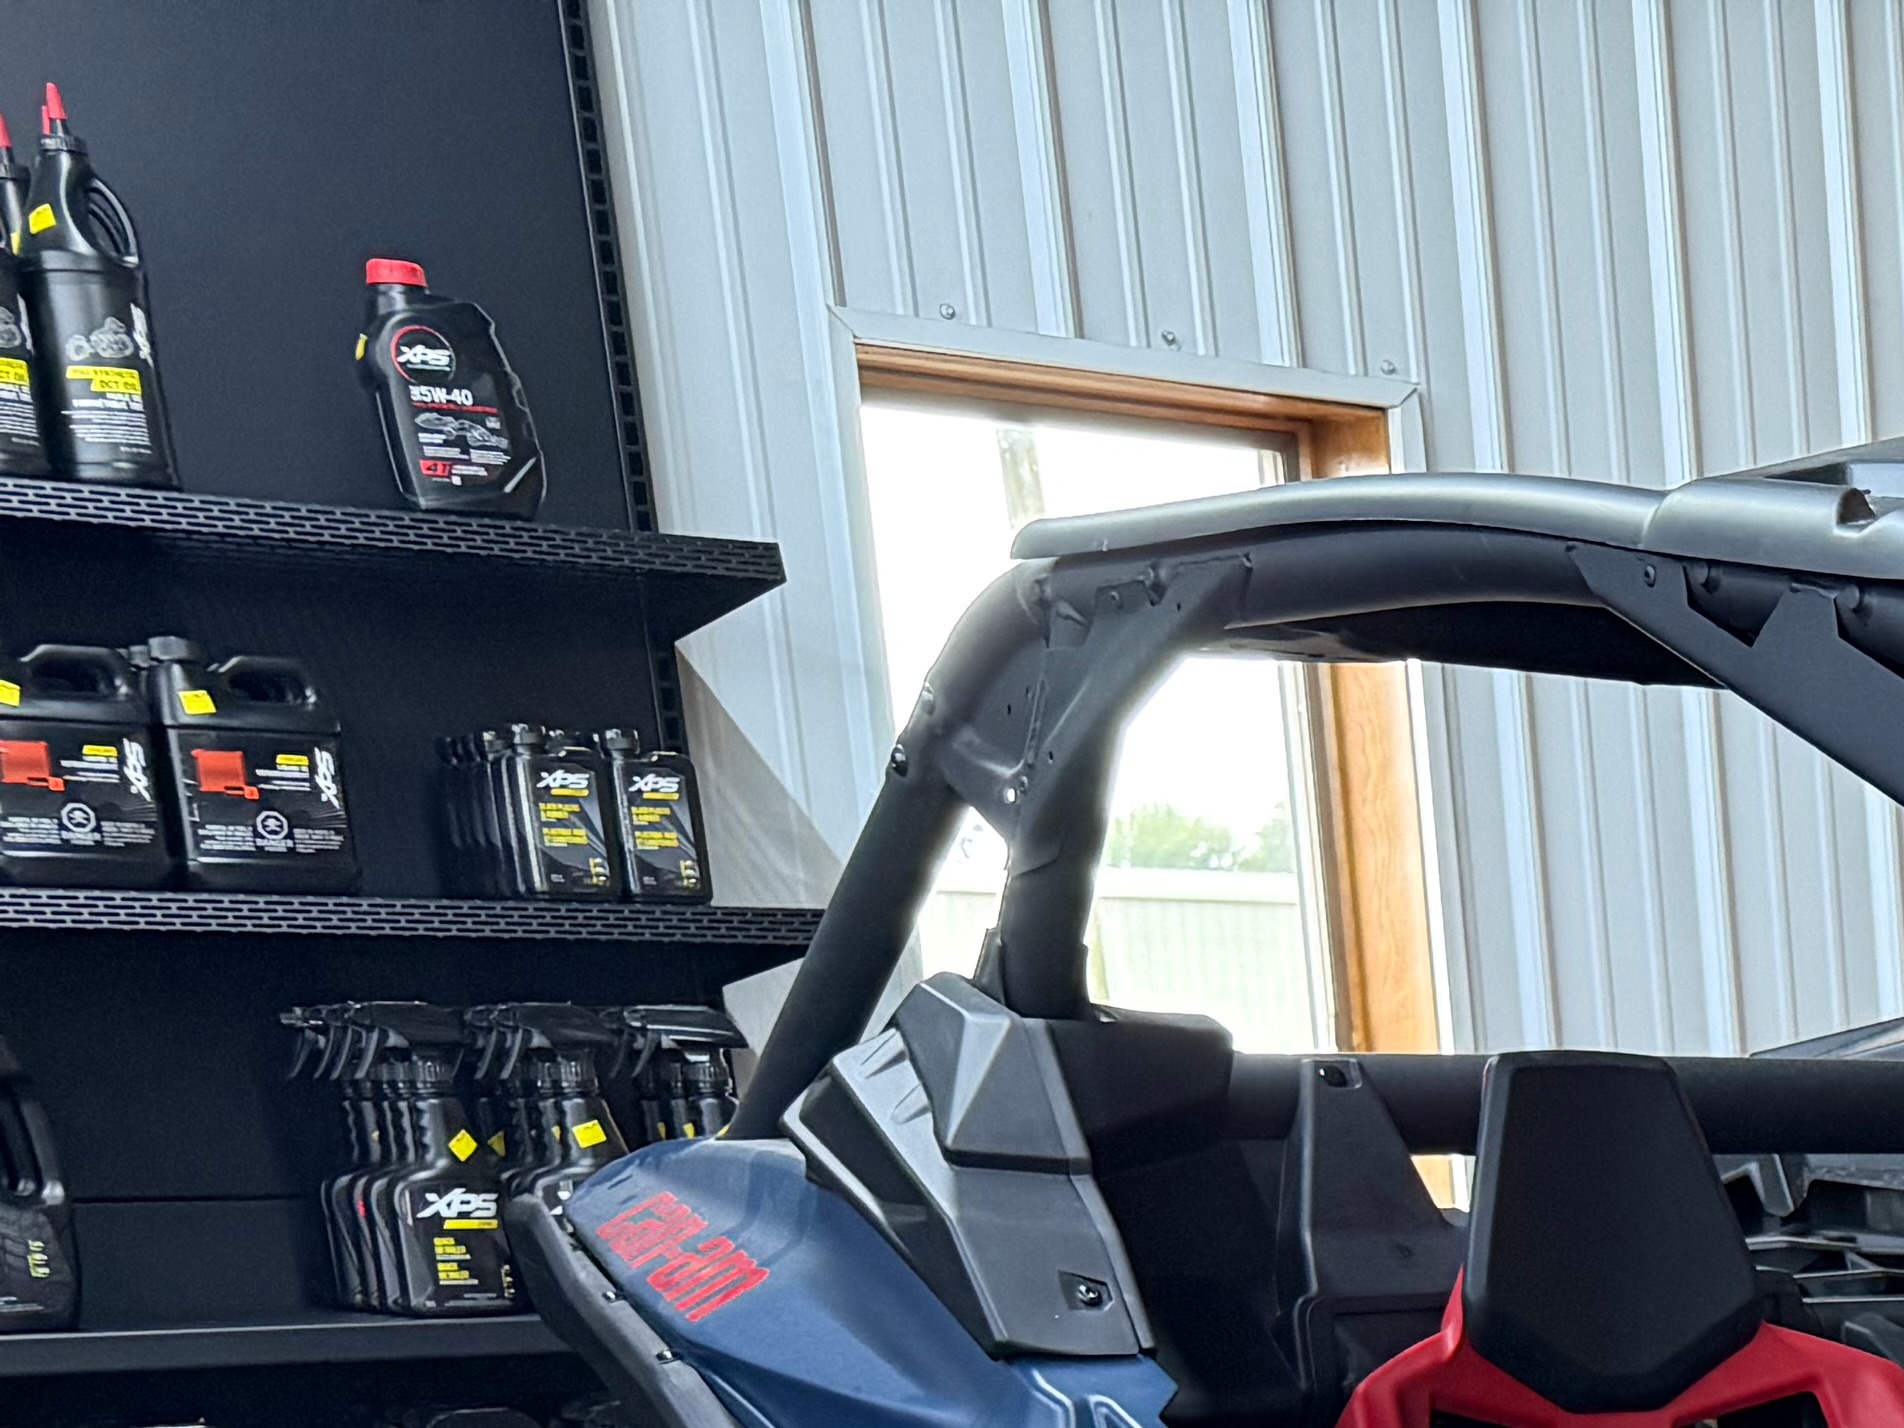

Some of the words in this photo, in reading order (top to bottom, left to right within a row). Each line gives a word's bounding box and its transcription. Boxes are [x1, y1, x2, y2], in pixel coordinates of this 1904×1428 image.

[396, 344, 451, 366] XPS
[536, 769, 591, 790] XPS
[628, 773, 681, 793] XPS
[416, 1188, 499, 1218] XPS
